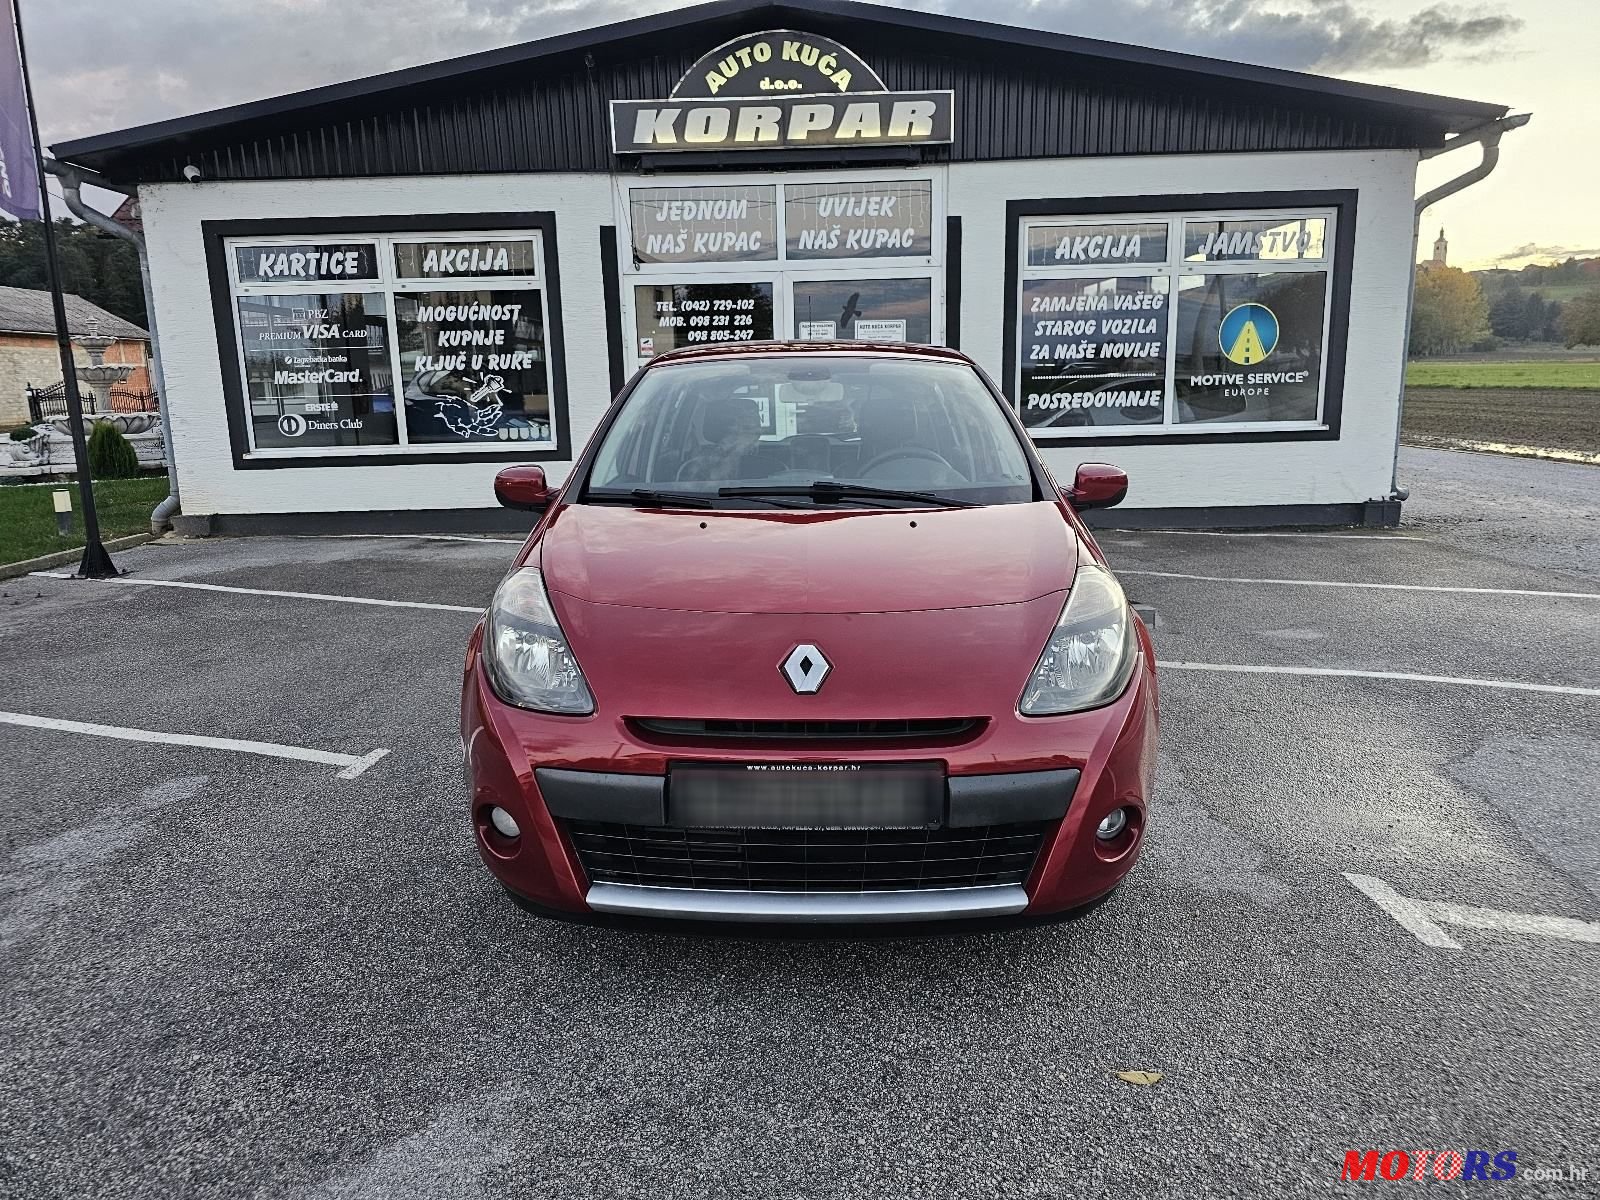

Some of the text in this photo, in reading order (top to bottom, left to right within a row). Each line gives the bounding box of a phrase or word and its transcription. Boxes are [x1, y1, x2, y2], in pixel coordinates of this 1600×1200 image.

[705, 40, 852, 95] AUTO KUĆA
[760, 77, 803, 90] d.o.o.
[633, 100, 937, 144] KORPAR
[656, 200, 750, 222] JEDNOM
[818, 196, 897, 218] UVIJEK
[646, 230, 763, 255] NAŠ KUPAC
[798, 225, 915, 250] NAŠ KUPAC
[1198, 231, 1312, 256] JAMSTVO
[1054, 235, 1142, 260] AKCIJA
[258, 251, 360, 278] KARTICE
[423, 248, 510, 273] AKCIJA
[656, 299, 755, 312] TEL. (042) 729-102
[1031, 291, 1164, 312] ZAMJENA VAŠEG
[308, 308, 329, 319] PBZ
[417, 301, 521, 322] MOGUĆNOST
[659, 314, 753, 327] MOB. 098 231 226
[259, 323, 368, 341] PREMIUM VISA CARD
[687, 329, 755, 341] 098 805-247
[1035, 318, 1157, 336] STAROG VOZILA
[438, 330, 505, 347] KUPNJE
[328, 354, 348, 363] banka
[1030, 341, 1161, 360] ZA NAŠE NOVIJE
[414, 353, 532, 372] KLJUČ U RUKE
[1190, 374, 1244, 387] MOTIVE
[1028, 391, 1162, 410] POSREDOVANJE
[1224, 388, 1270, 397] EUROPE
[305, 402, 331, 412] ERSTE
[308, 418, 363, 430] Diners Club
